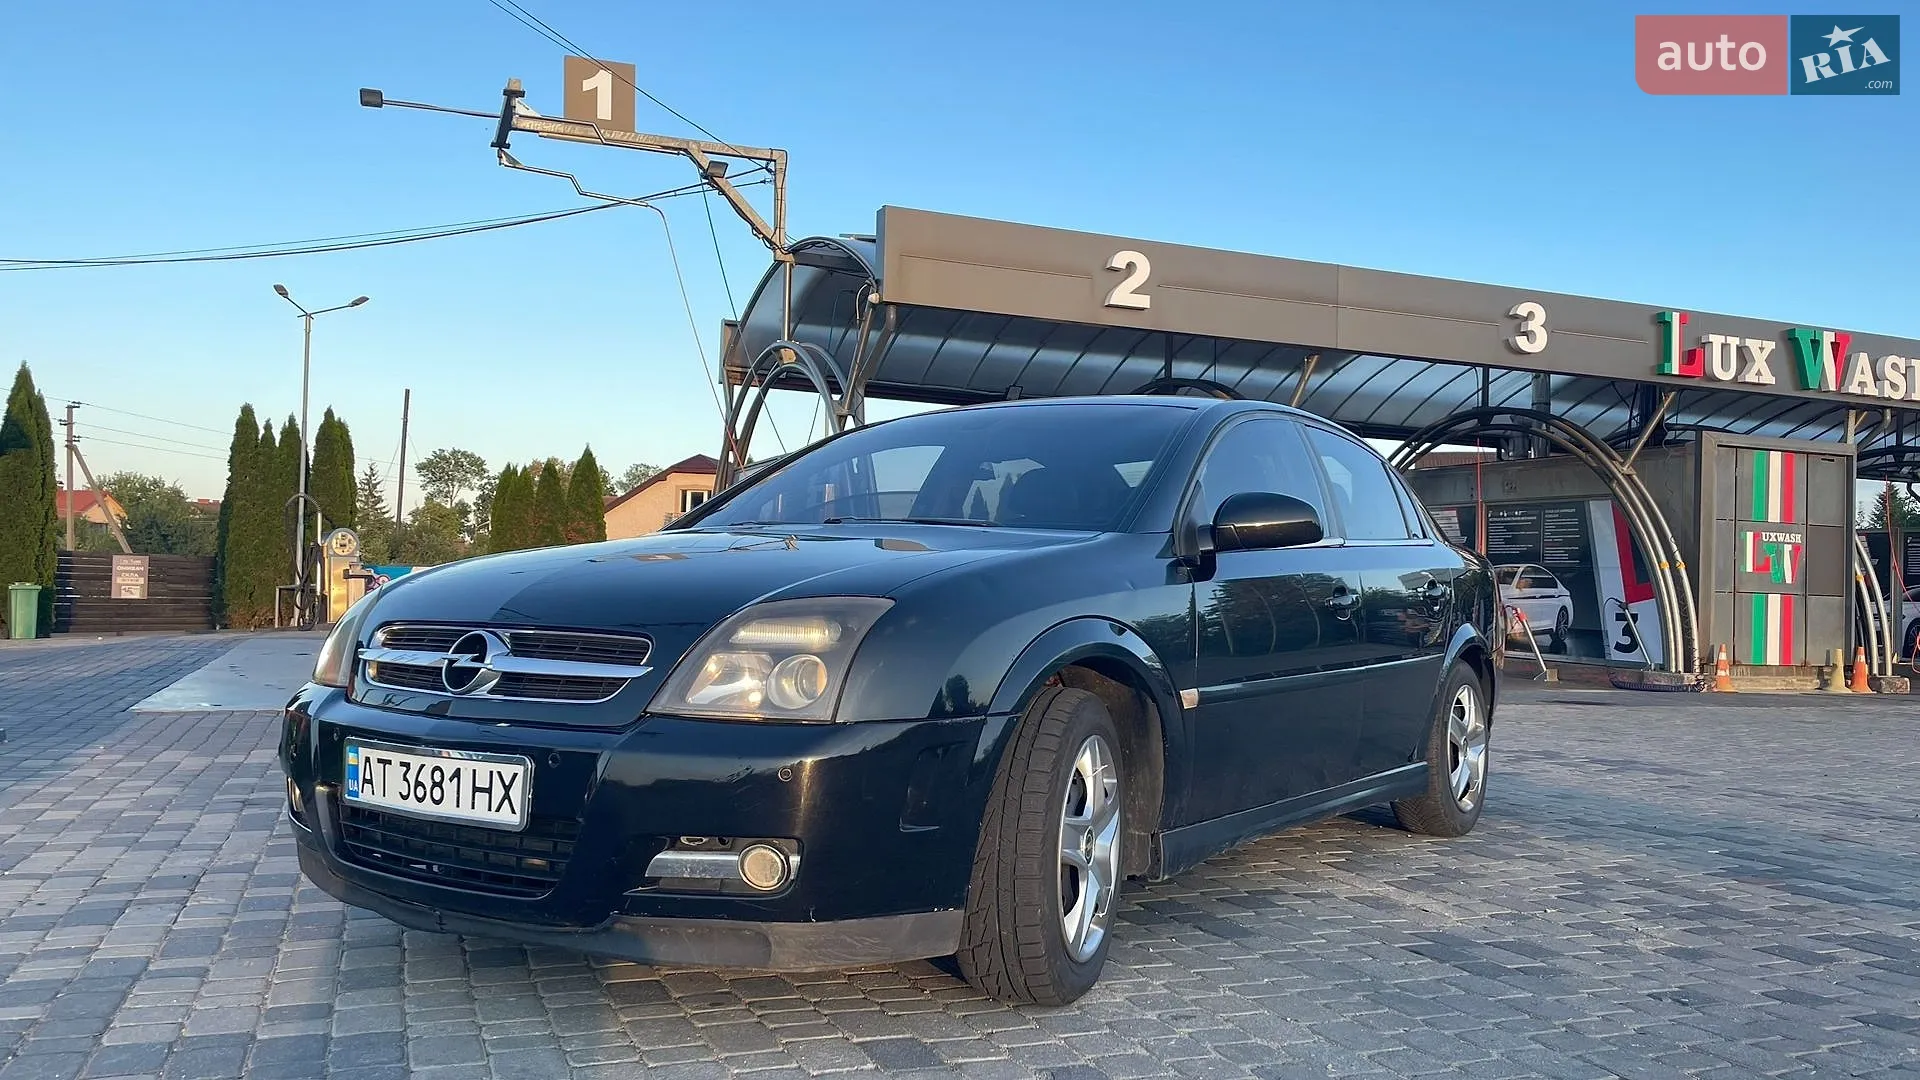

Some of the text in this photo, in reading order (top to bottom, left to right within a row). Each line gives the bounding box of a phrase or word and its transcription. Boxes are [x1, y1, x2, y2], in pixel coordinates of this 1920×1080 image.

[582, 69, 612, 120] 1
[1104, 250, 1151, 309] 2
[1508, 302, 1548, 354] 3
[1656, 311, 1776, 385] LUX
[1613, 612, 1639, 654] 3
[348, 778, 359, 792] UA
[361, 756, 519, 815] AT 3681 HX
